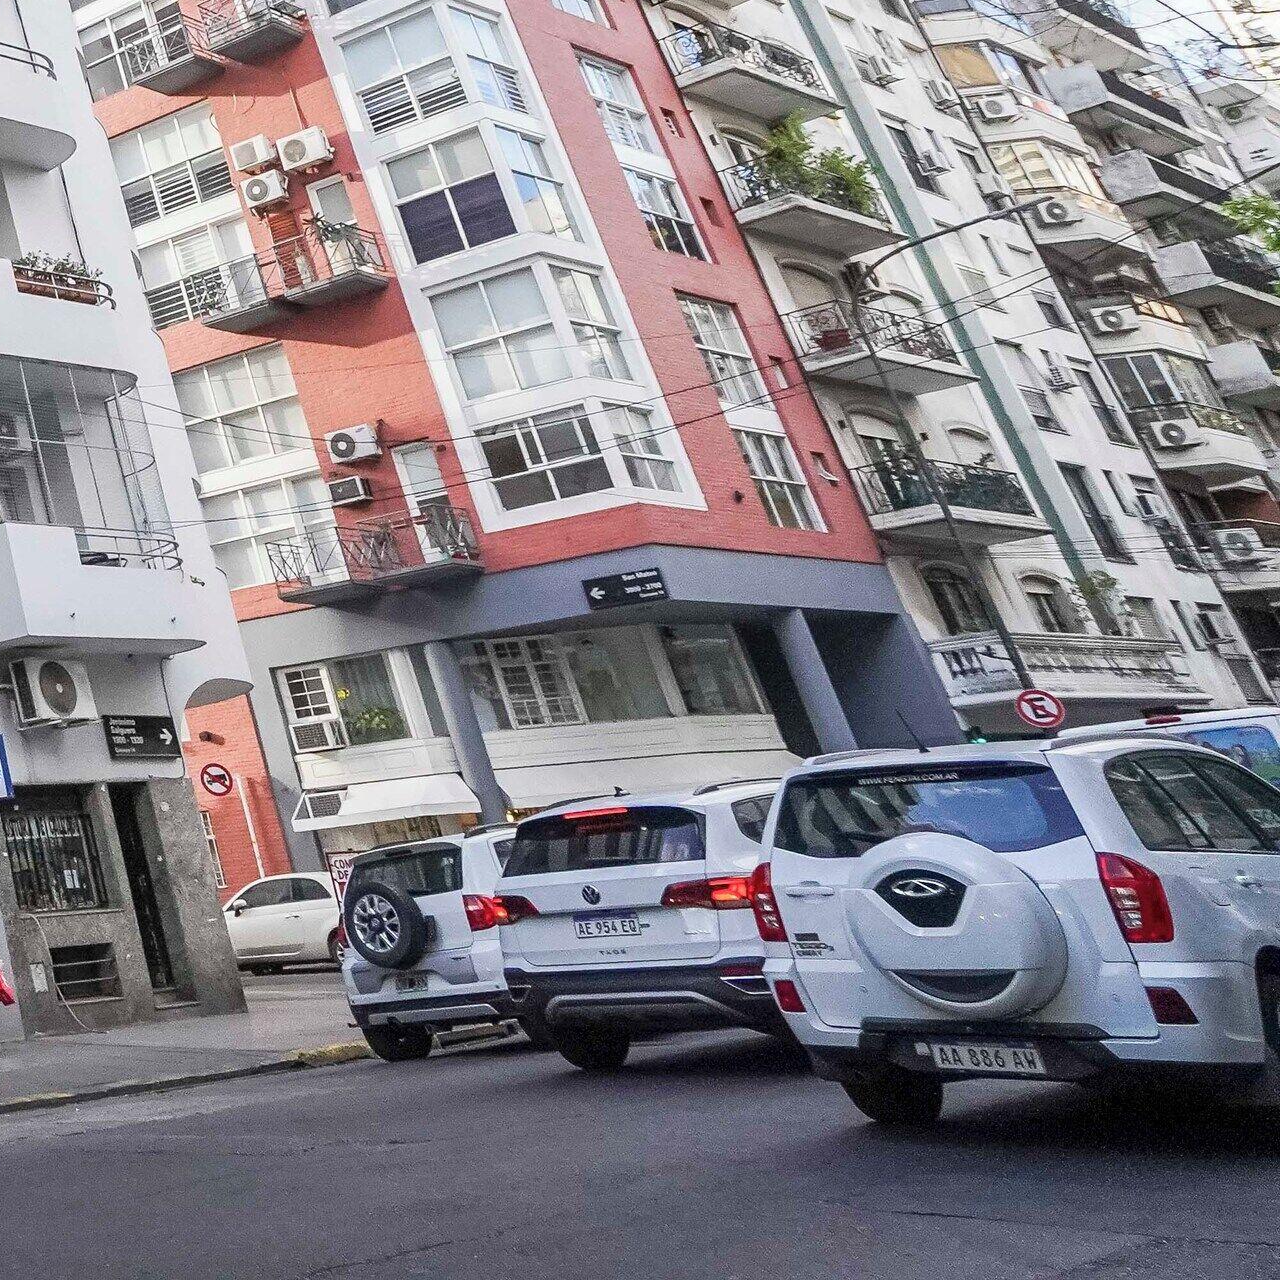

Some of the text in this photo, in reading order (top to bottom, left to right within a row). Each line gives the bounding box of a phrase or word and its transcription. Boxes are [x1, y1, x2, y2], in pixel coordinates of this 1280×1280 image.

[579, 923, 593, 935] AE
[596, 921, 618, 934] 954
[940, 1047, 1037, 1069] AA 886 AW
